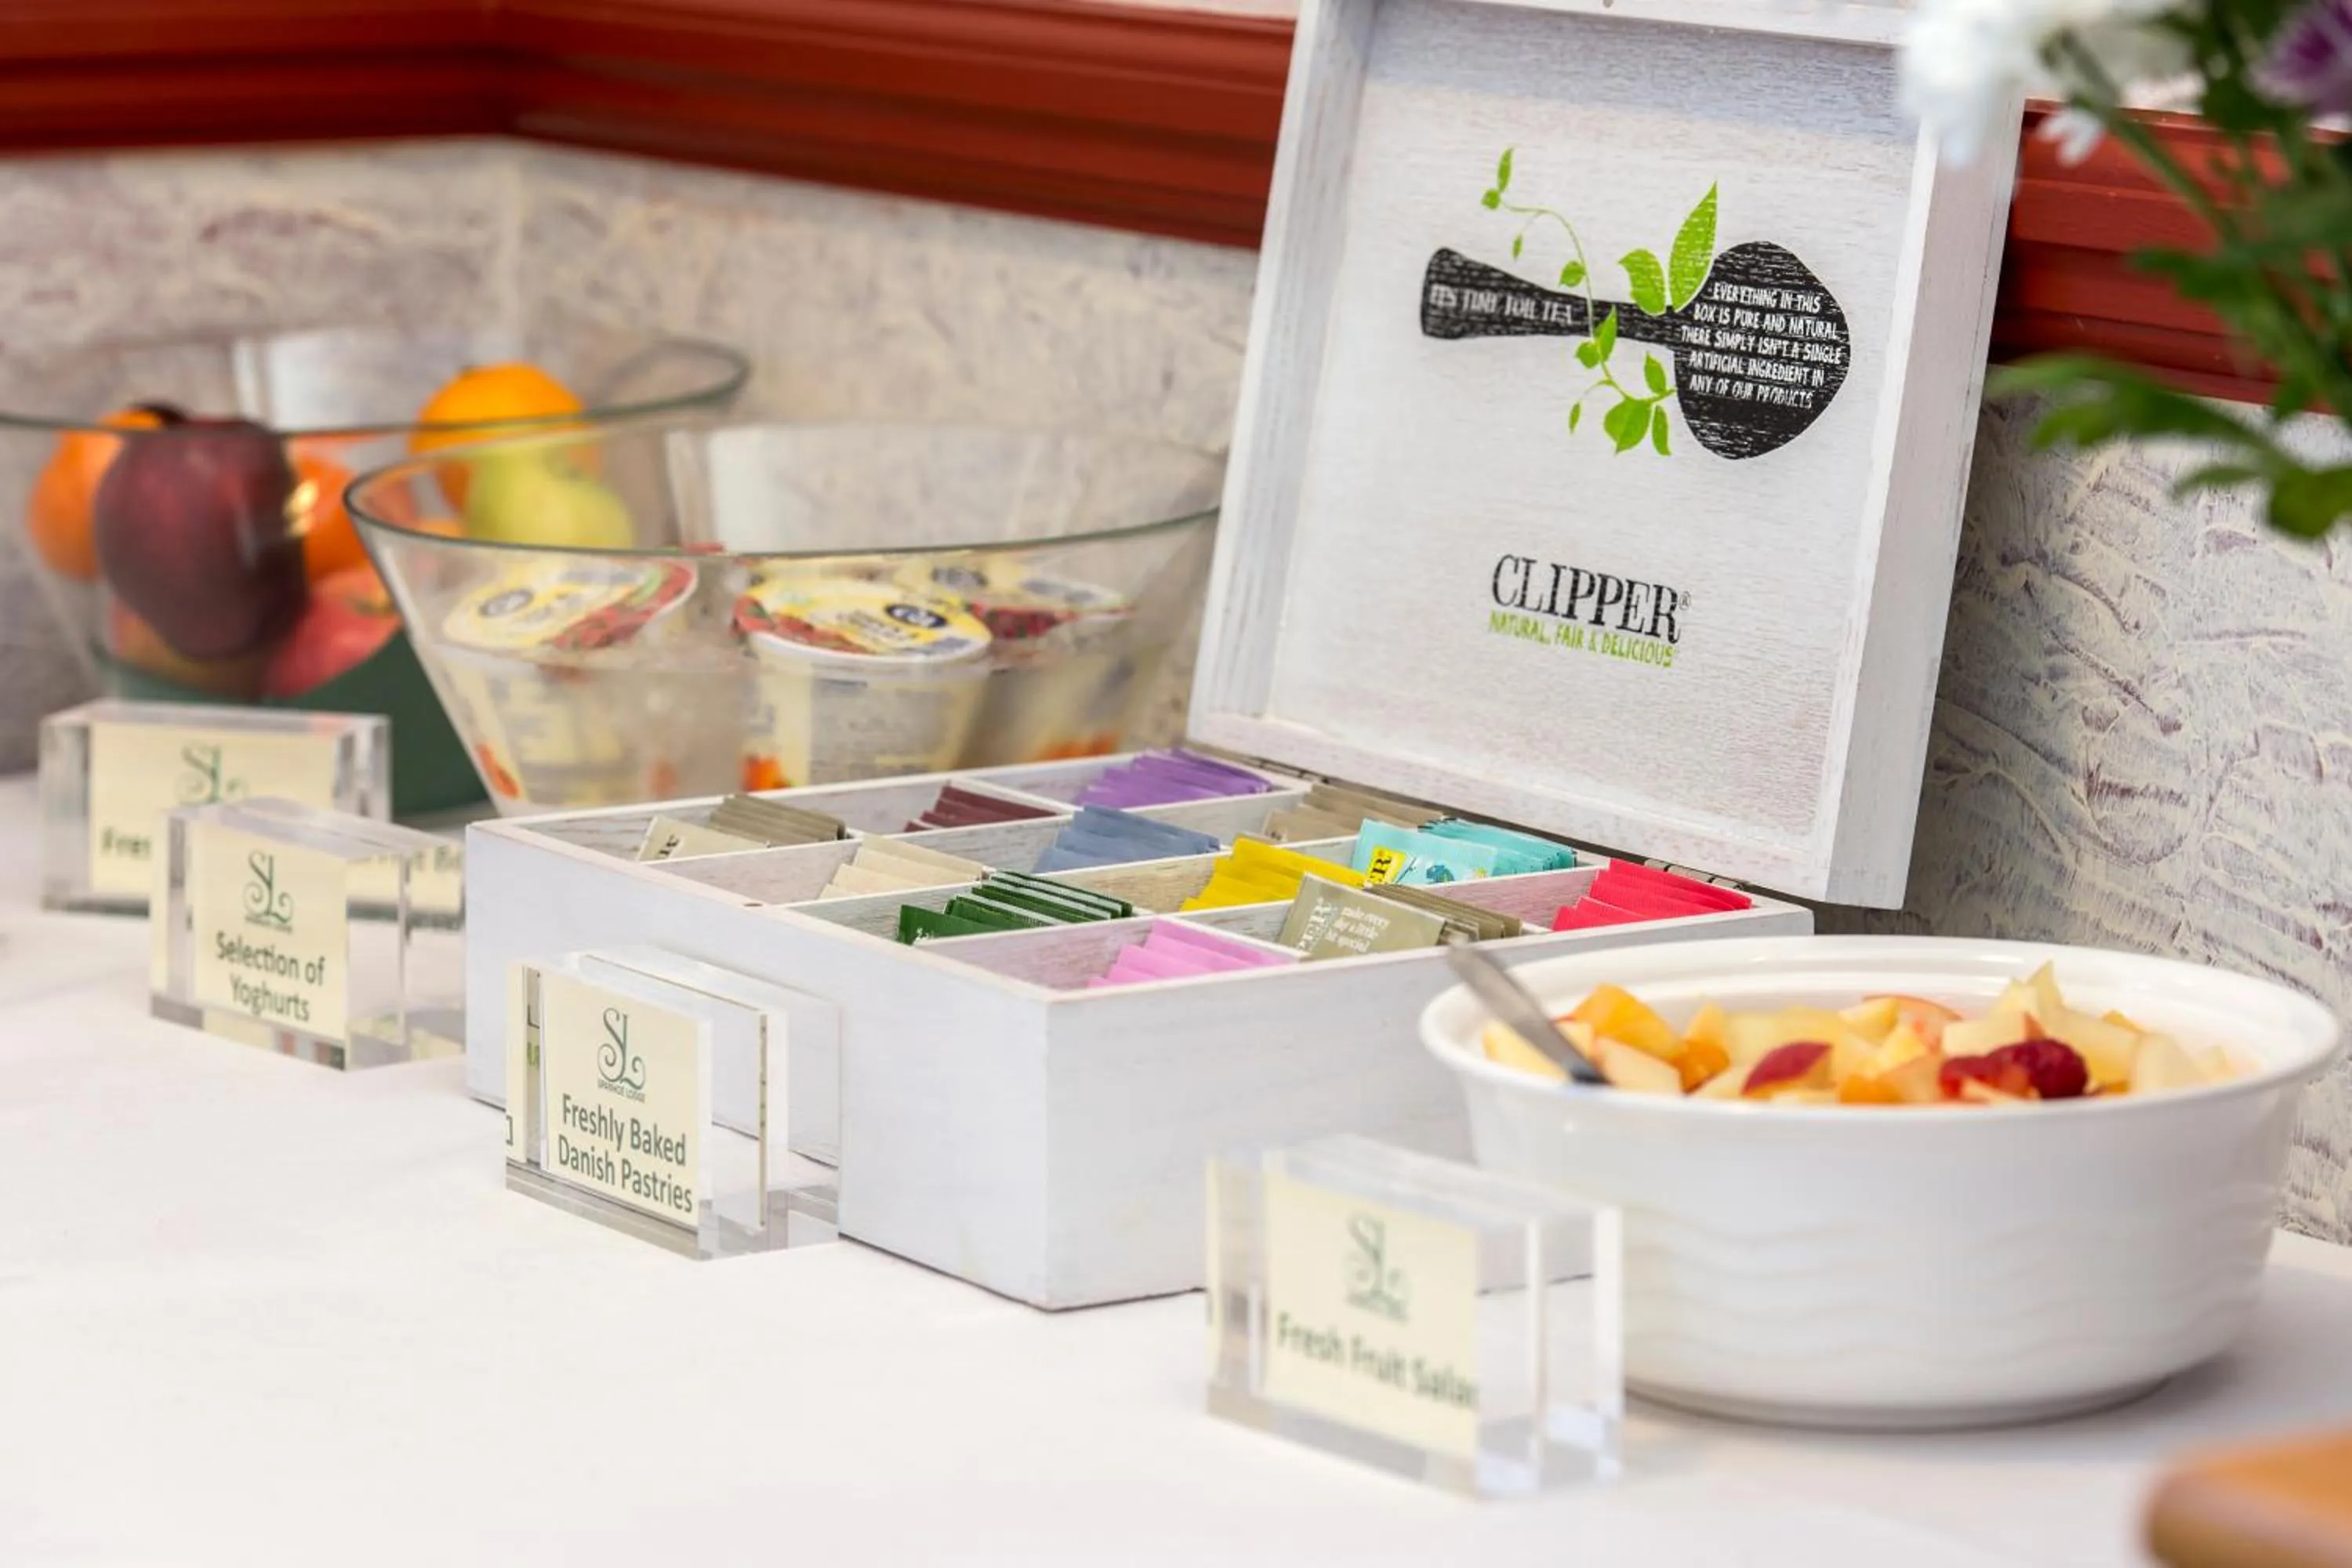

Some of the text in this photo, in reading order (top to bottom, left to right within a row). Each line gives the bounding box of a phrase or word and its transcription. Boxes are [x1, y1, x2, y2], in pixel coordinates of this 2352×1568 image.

[1693, 303, 1715, 322] BOX
[1719, 307, 1730, 325] IS
[1733, 308, 1760, 329] PURE
[1763, 313, 1786, 332] AND
[1713, 282, 1777, 308] EVERYTHING
[1798, 294, 1820, 314] THIS
[1681, 325, 1711, 347] THERE
[1714, 329, 1755, 352] SIMPLY
[1791, 340, 1799, 358] A
[1802, 343, 1842, 365] SINGLE
[1690, 351, 1824, 387] ARTIFICIAL INGREDIENT IN
[1690, 374, 1713, 393] ANY
[1715, 378, 1730, 395] OF
[1732, 380, 1753, 401] OUR
[1555, 624, 1584, 649] FAIR
[1602, 632, 1675, 668] DELICIOUS
[216, 930, 325, 986] Selection of
[230, 973, 310, 1022] Yoghurts
[562, 1093, 686, 1167] Freshly Baked
[558, 1134, 692, 1214] Danish Pastries
[1278, 1312, 1345, 1365] Fresh
[1349, 1333, 1406, 1391] Fruit
